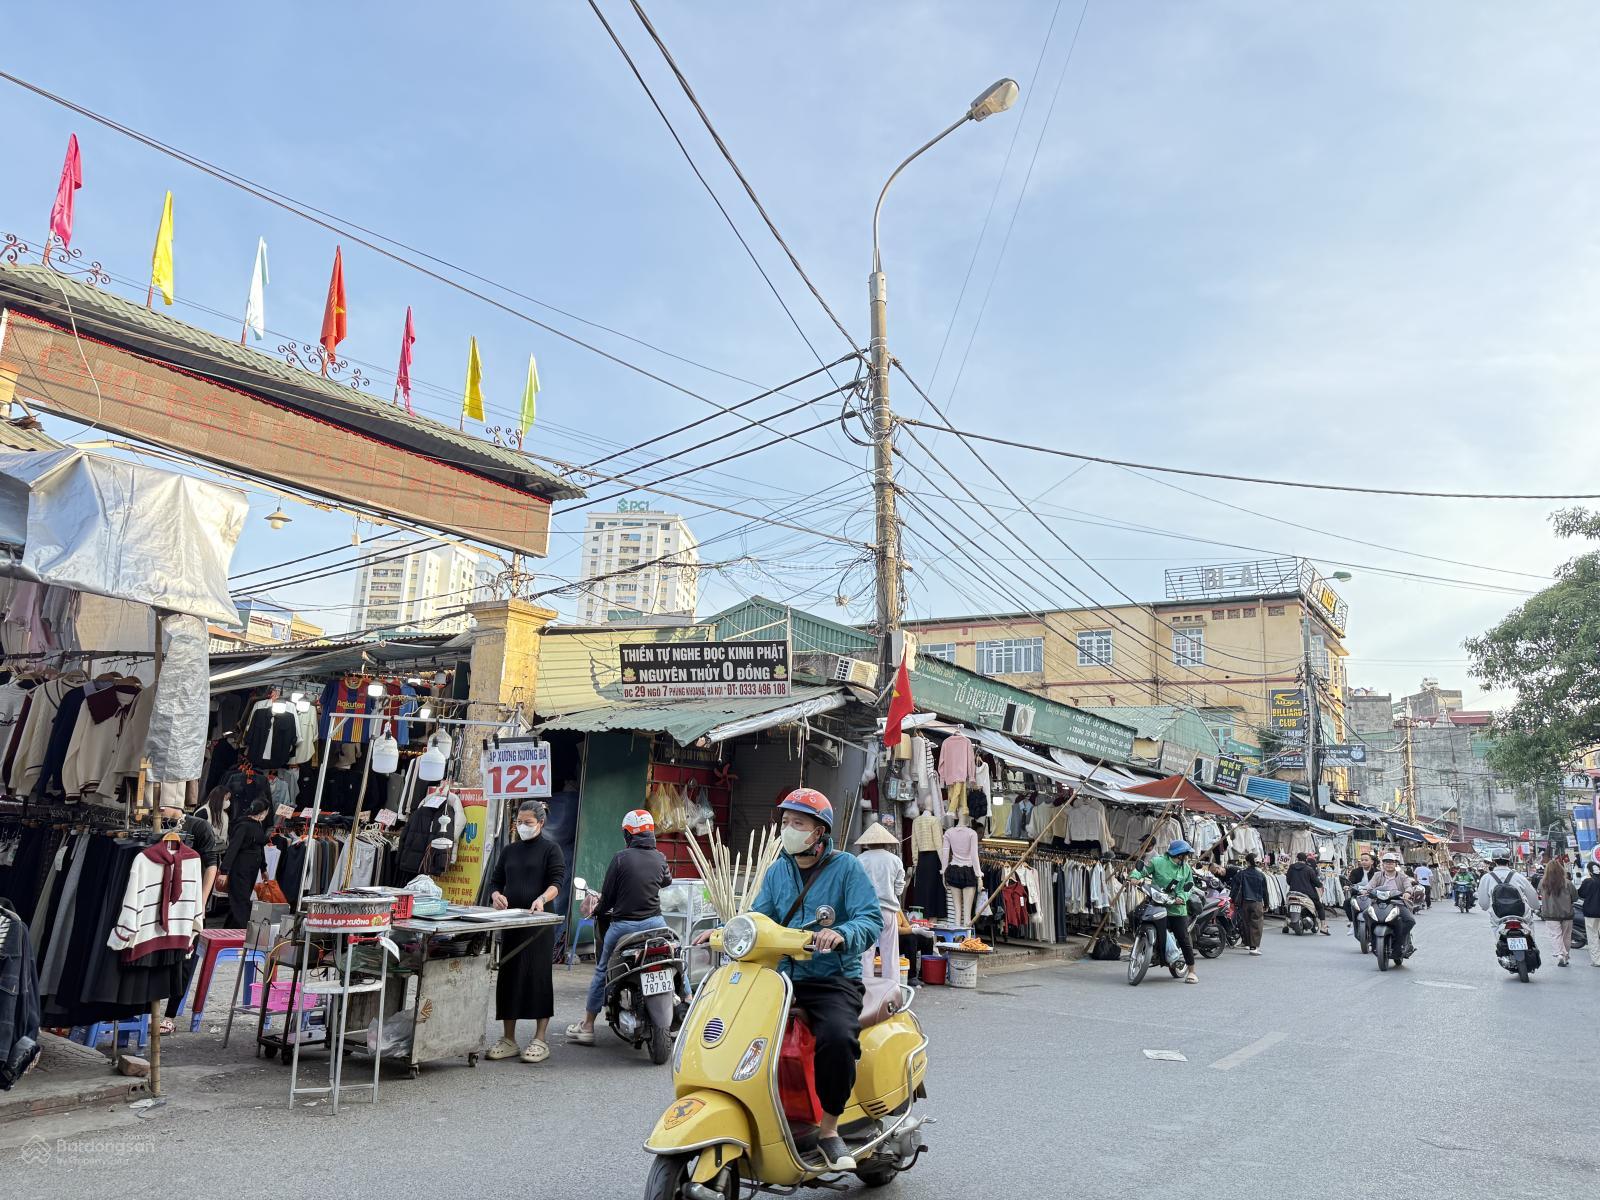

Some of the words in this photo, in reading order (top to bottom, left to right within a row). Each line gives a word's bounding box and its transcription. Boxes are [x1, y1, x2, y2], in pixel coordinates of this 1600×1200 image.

[622, 645, 654, 662] THIỀN
[656, 646, 670, 664] TỰ
[672, 648, 701, 662] NGHE
[703, 647, 725, 663] ĐỌC
[728, 646, 754, 660] KINH
[757, 643, 785, 662] PHẬT
[638, 666, 687, 683] NGUYÊN
[691, 663, 720, 681] THỦY
[722, 661, 734, 681] 0
[736, 663, 770, 680] ĐỒNG
[635, 685, 646, 698] 29
[662, 685, 668, 697] 7
[739, 684, 756, 695] 0333
[758, 683, 772, 695] 496
[773, 683, 786, 695] 108
[337, 699, 366, 709] Rakuten
[1280, 718, 1297, 727] CLUB
[488, 764, 547, 794] 12K
[646, 971, 668, 983] 29-G1
[645, 980, 672, 995] 787.82
